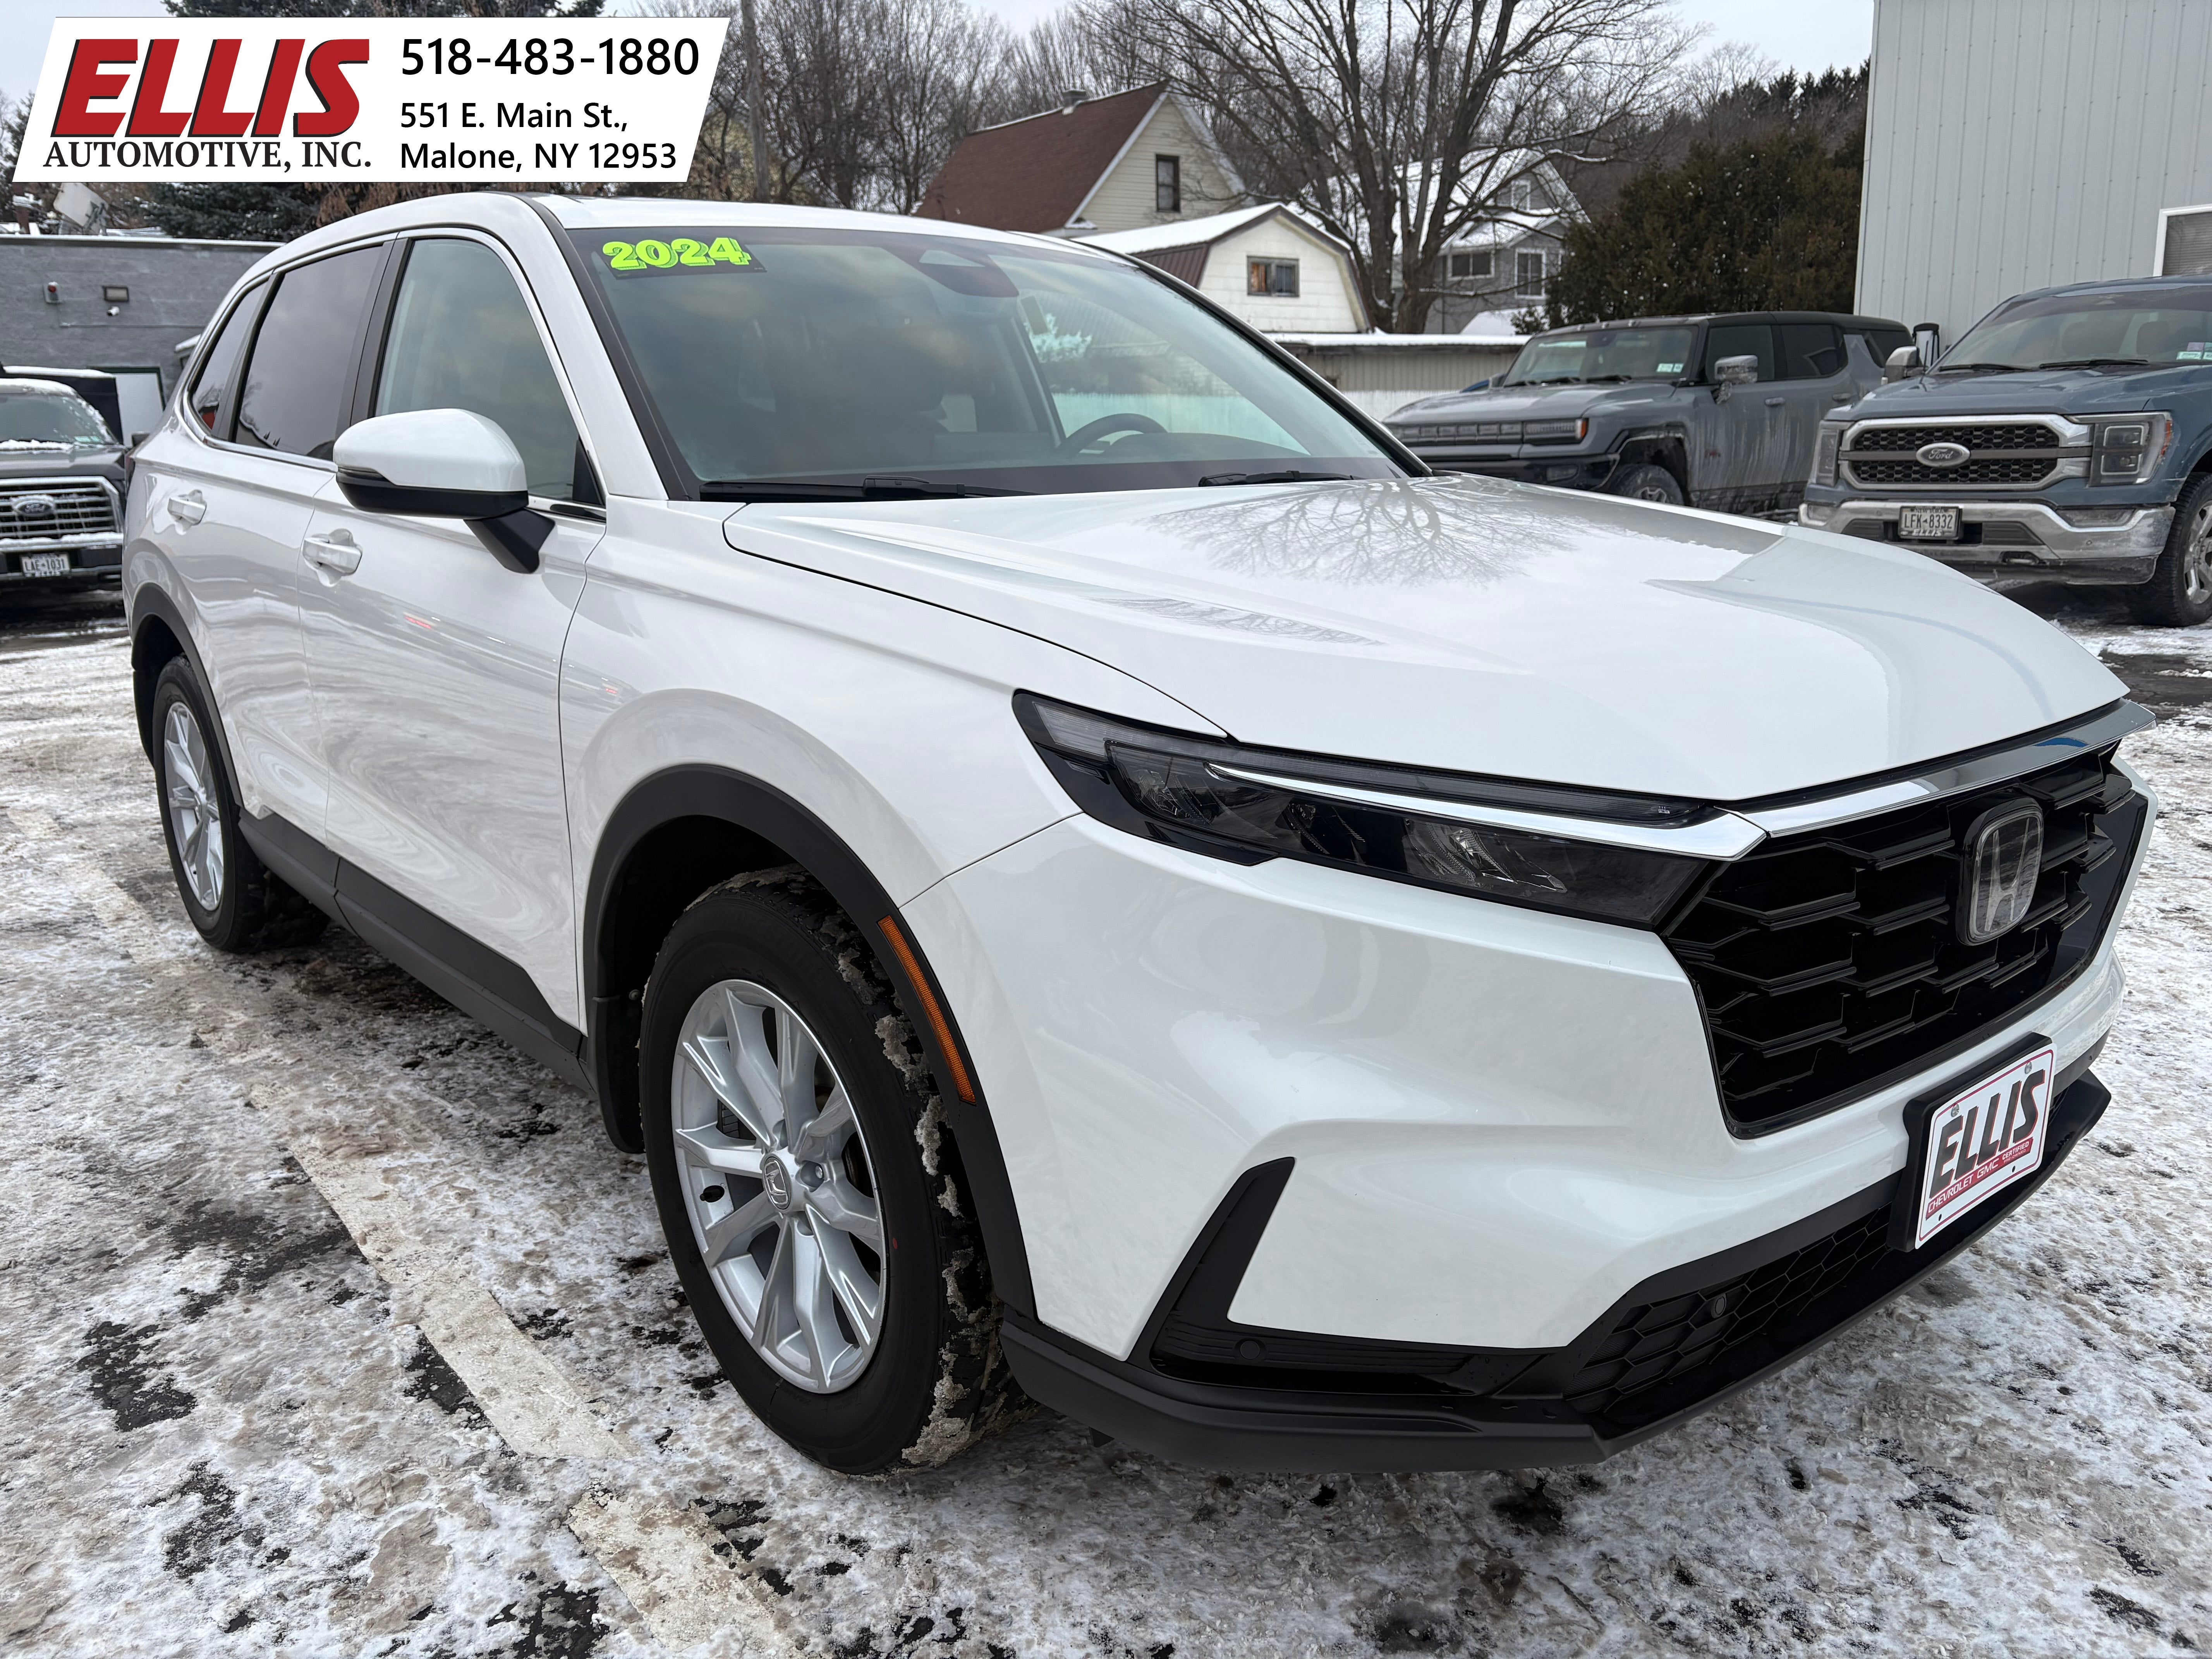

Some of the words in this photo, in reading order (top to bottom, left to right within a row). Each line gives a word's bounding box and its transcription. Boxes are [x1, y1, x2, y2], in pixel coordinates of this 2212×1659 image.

[603, 237, 752, 270] 2024
[1929, 448, 1953, 459] Ford
[1929, 1069, 2045, 1199] ELLIS
[1928, 1174, 1974, 1213] CHEVROLET
[1977, 1158, 1999, 1179] GMC
[2002, 1141, 2029, 1160] CERTIFIED
